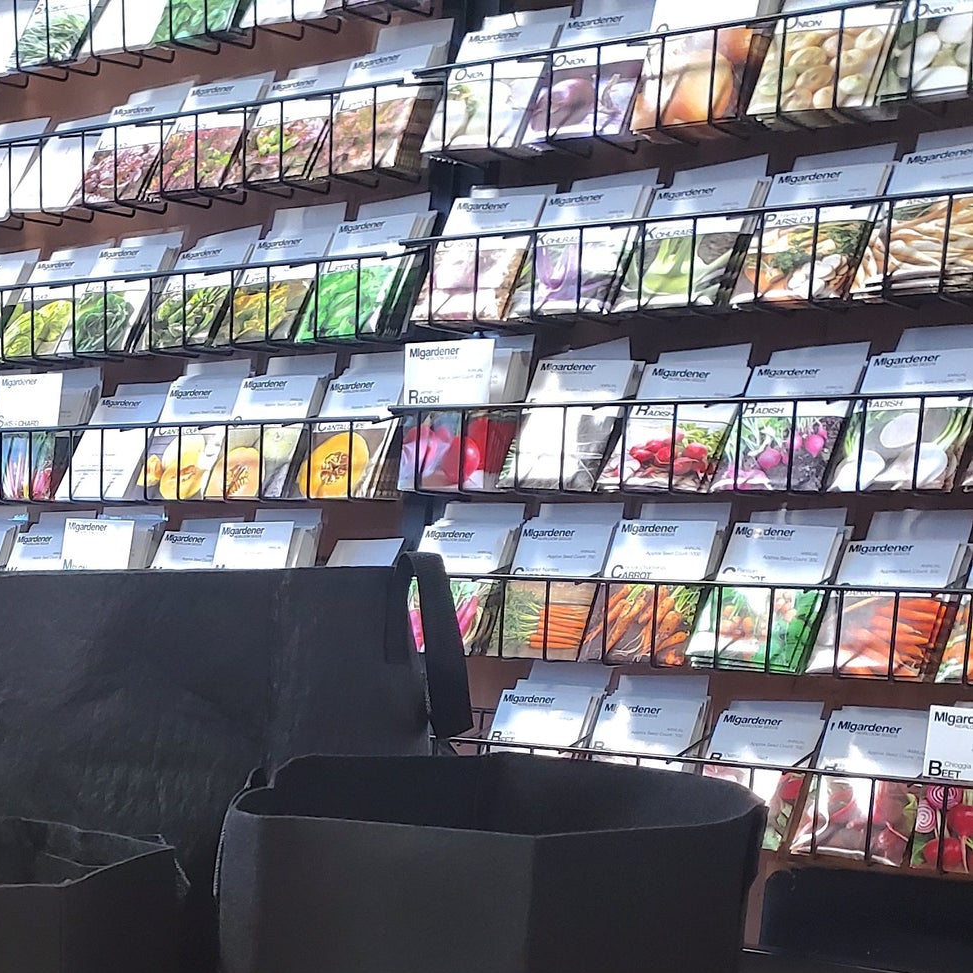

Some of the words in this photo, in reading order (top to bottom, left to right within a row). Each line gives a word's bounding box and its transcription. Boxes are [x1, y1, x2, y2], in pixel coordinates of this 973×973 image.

[409, 346, 460, 360] MIgardener
[874, 354, 941, 369] MIgardener
[651, 367, 711, 379] MIgardener
[757, 368, 821, 378] MIgardener
[408, 389, 440, 405] RADISH
[523, 529, 575, 540] MIgardener
[621, 524, 679, 535] MIgardener
[735, 526, 795, 538] MIgdener
[848, 544, 914, 555] MIgardener
[611, 564, 652, 580] CARROT
[503, 694, 555, 705] MIgardener
[723, 714, 783, 726] MIgardener
[838, 720, 902, 734] MIgardener
[928, 760, 962, 779] BEET
